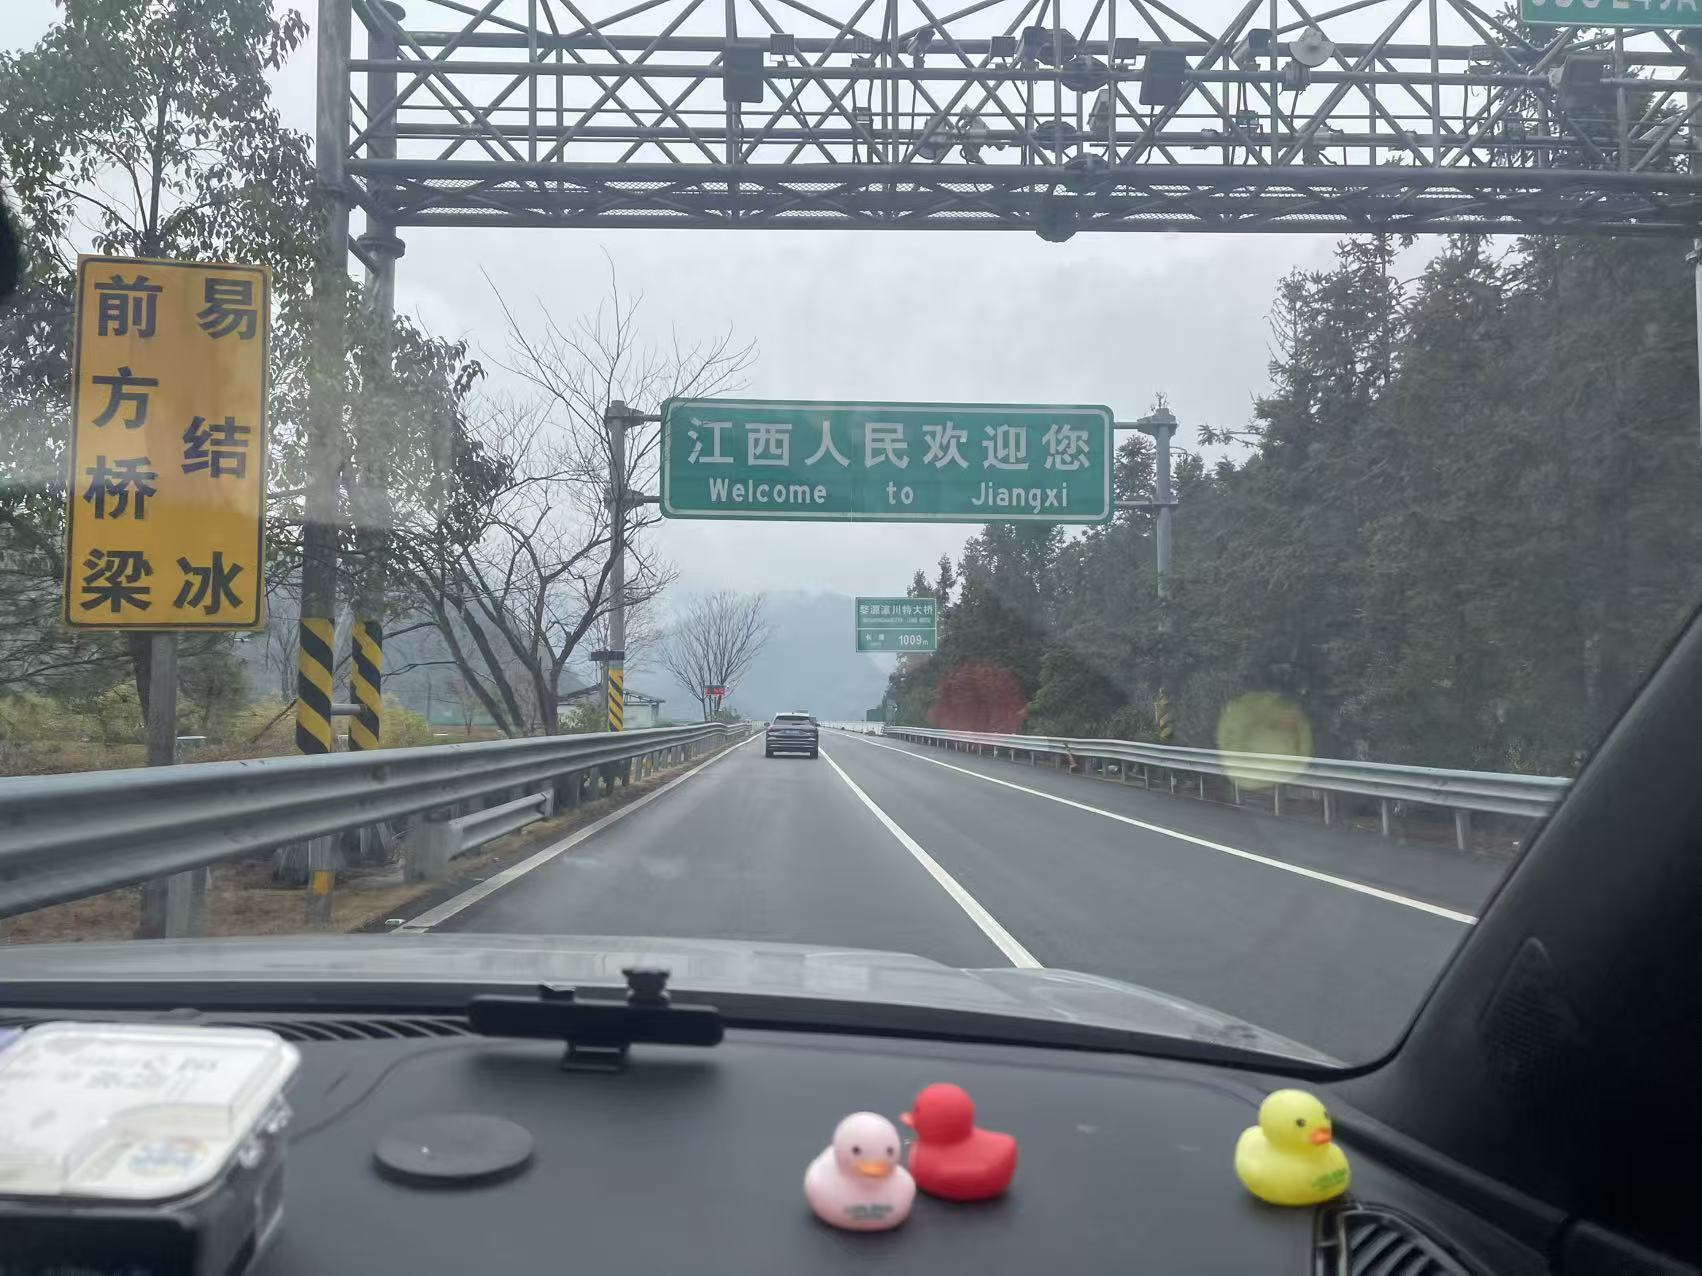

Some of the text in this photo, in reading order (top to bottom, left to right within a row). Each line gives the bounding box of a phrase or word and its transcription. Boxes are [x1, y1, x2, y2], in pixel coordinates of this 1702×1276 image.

[80, 274, 163, 613] 前方桥梁
[173, 276, 258, 615] 易结冰
[687, 418, 1090, 471] 江西人民欢迎您
[708, 478, 1069, 514] Welcome to Jiangxi
